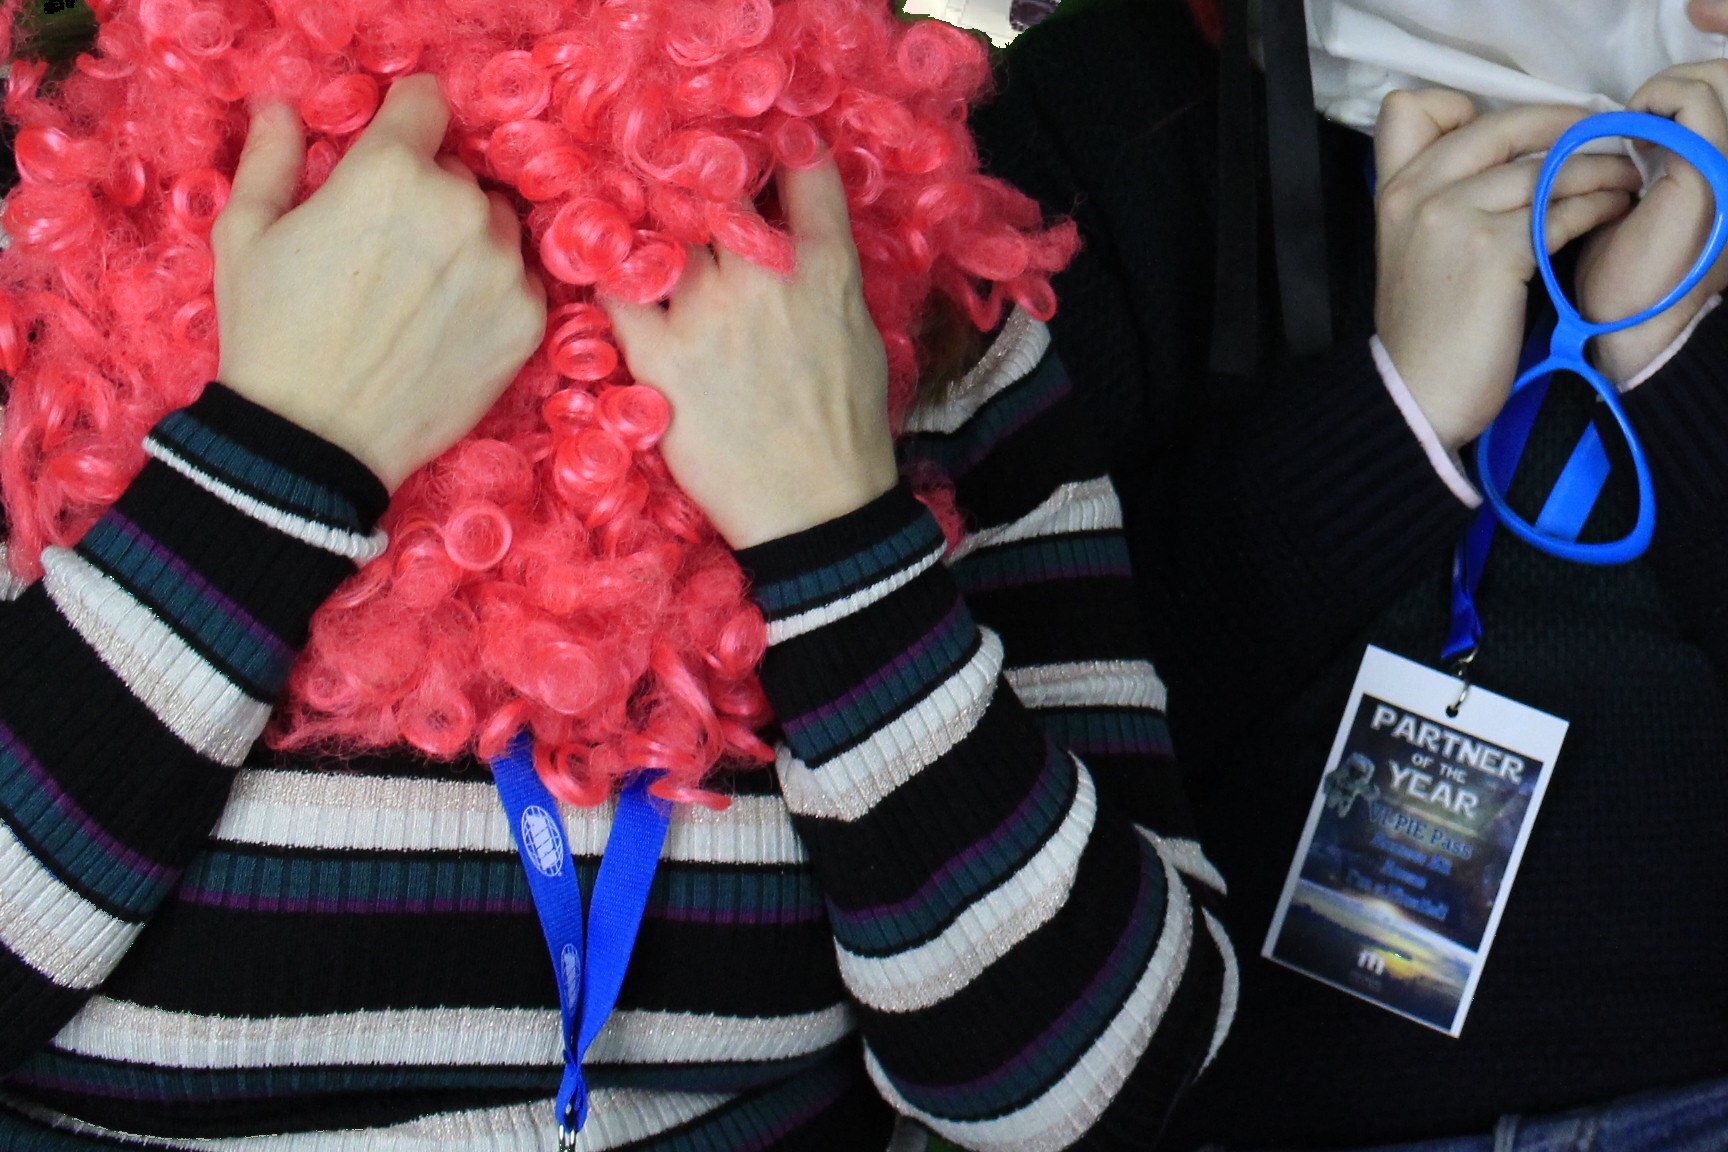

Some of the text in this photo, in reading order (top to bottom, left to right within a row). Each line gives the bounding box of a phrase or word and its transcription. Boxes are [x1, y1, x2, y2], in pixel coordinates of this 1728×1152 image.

[1370, 705, 1524, 784] PARTNER
[1387, 760, 1479, 820] YEAR
[1411, 753, 1467, 785] OF THE
[1430, 828, 1474, 861] Pass
